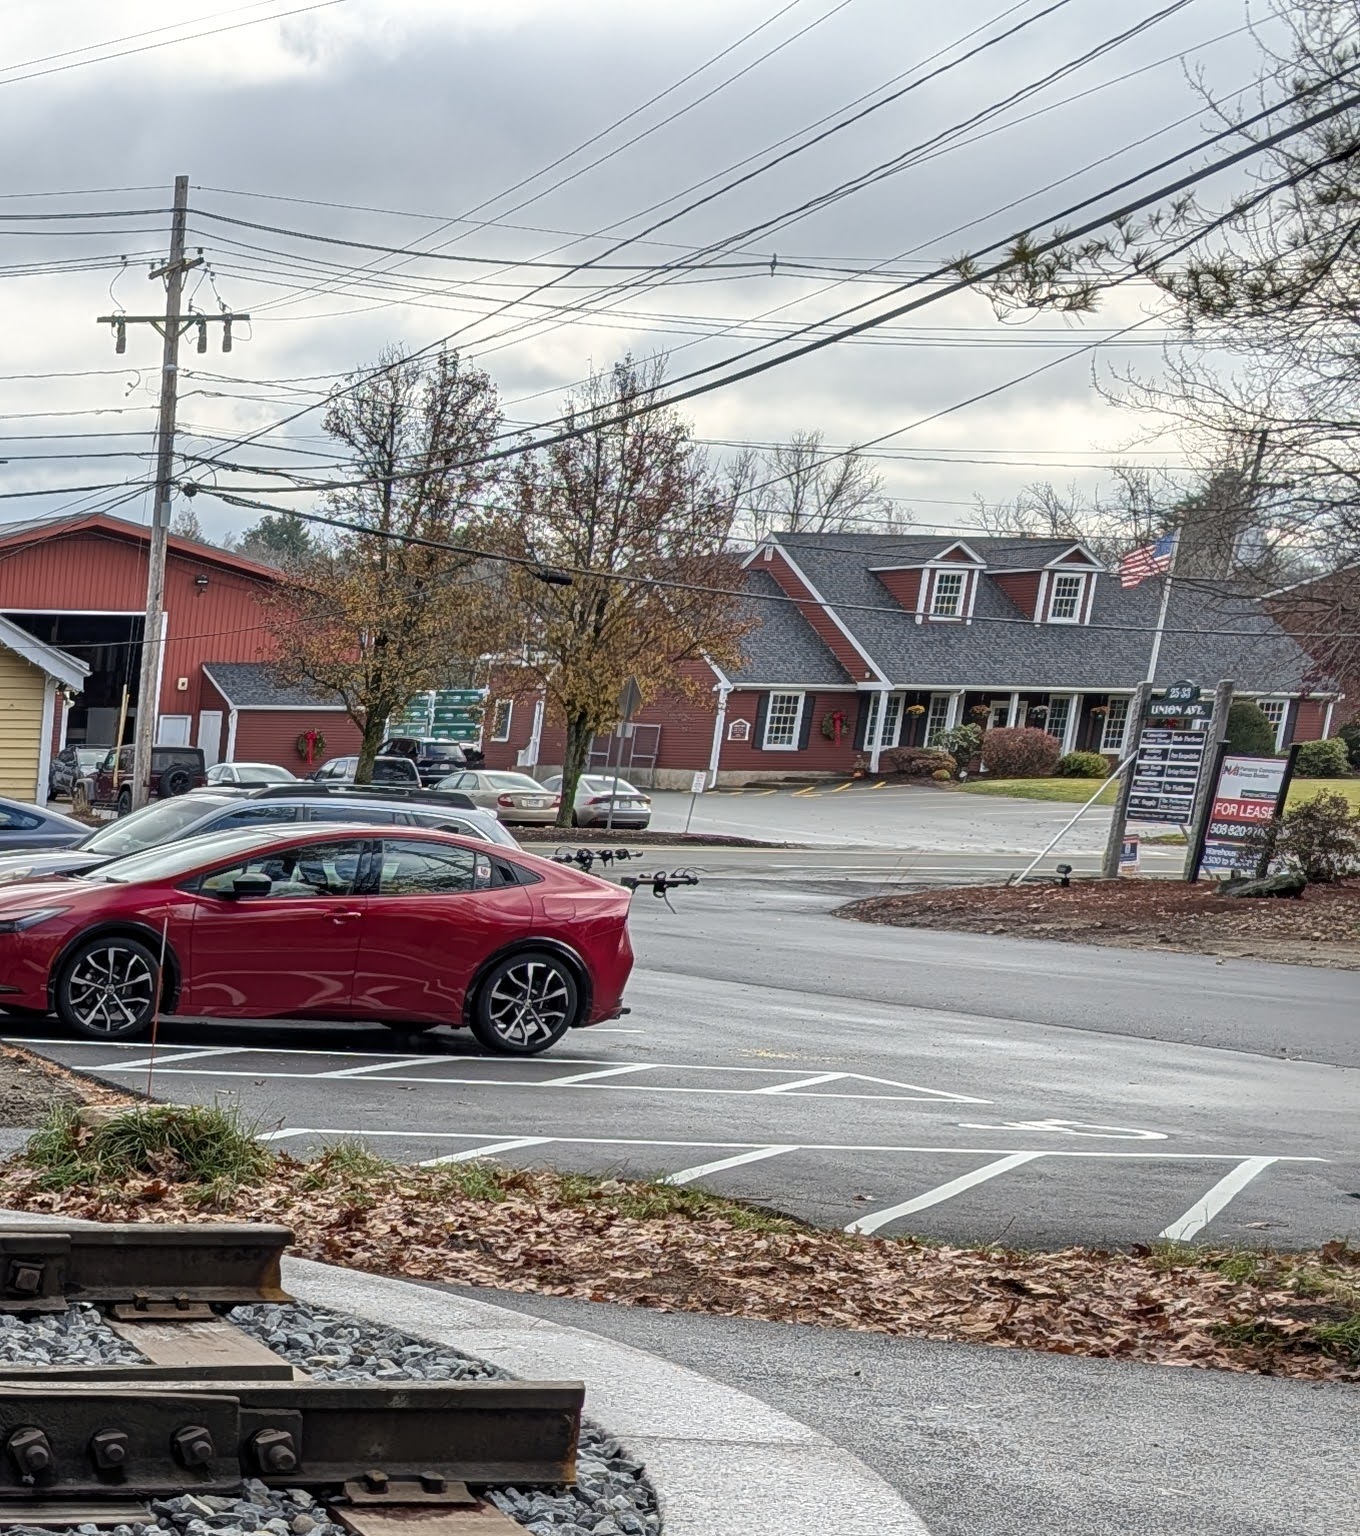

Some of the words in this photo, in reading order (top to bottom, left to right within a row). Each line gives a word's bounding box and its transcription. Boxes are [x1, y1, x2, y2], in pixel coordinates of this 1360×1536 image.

[1151, 705, 1183, 715] UNION
[1214, 803, 1238, 816] FOR
[1240, 804, 1275, 820] LEASE
